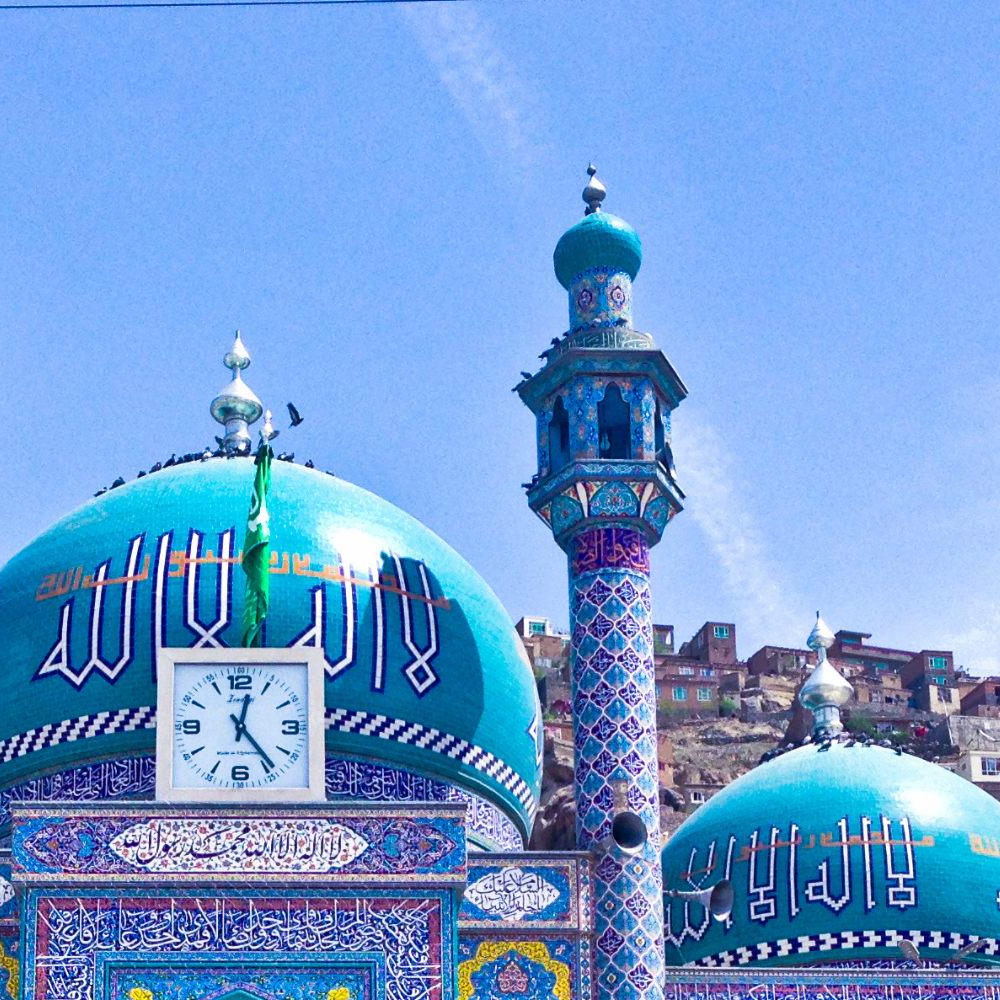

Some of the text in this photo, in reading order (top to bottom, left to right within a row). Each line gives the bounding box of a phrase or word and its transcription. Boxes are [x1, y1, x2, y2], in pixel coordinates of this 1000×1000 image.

[31, 530, 173, 692] الله
[393, 546, 440, 699] لا
[227, 675, 253, 690] 12
[182, 719, 201, 735] 9
[281, 719, 300, 735] 3
[231, 765, 250, 781] 6
[189, 826, 252, 860] محمد
